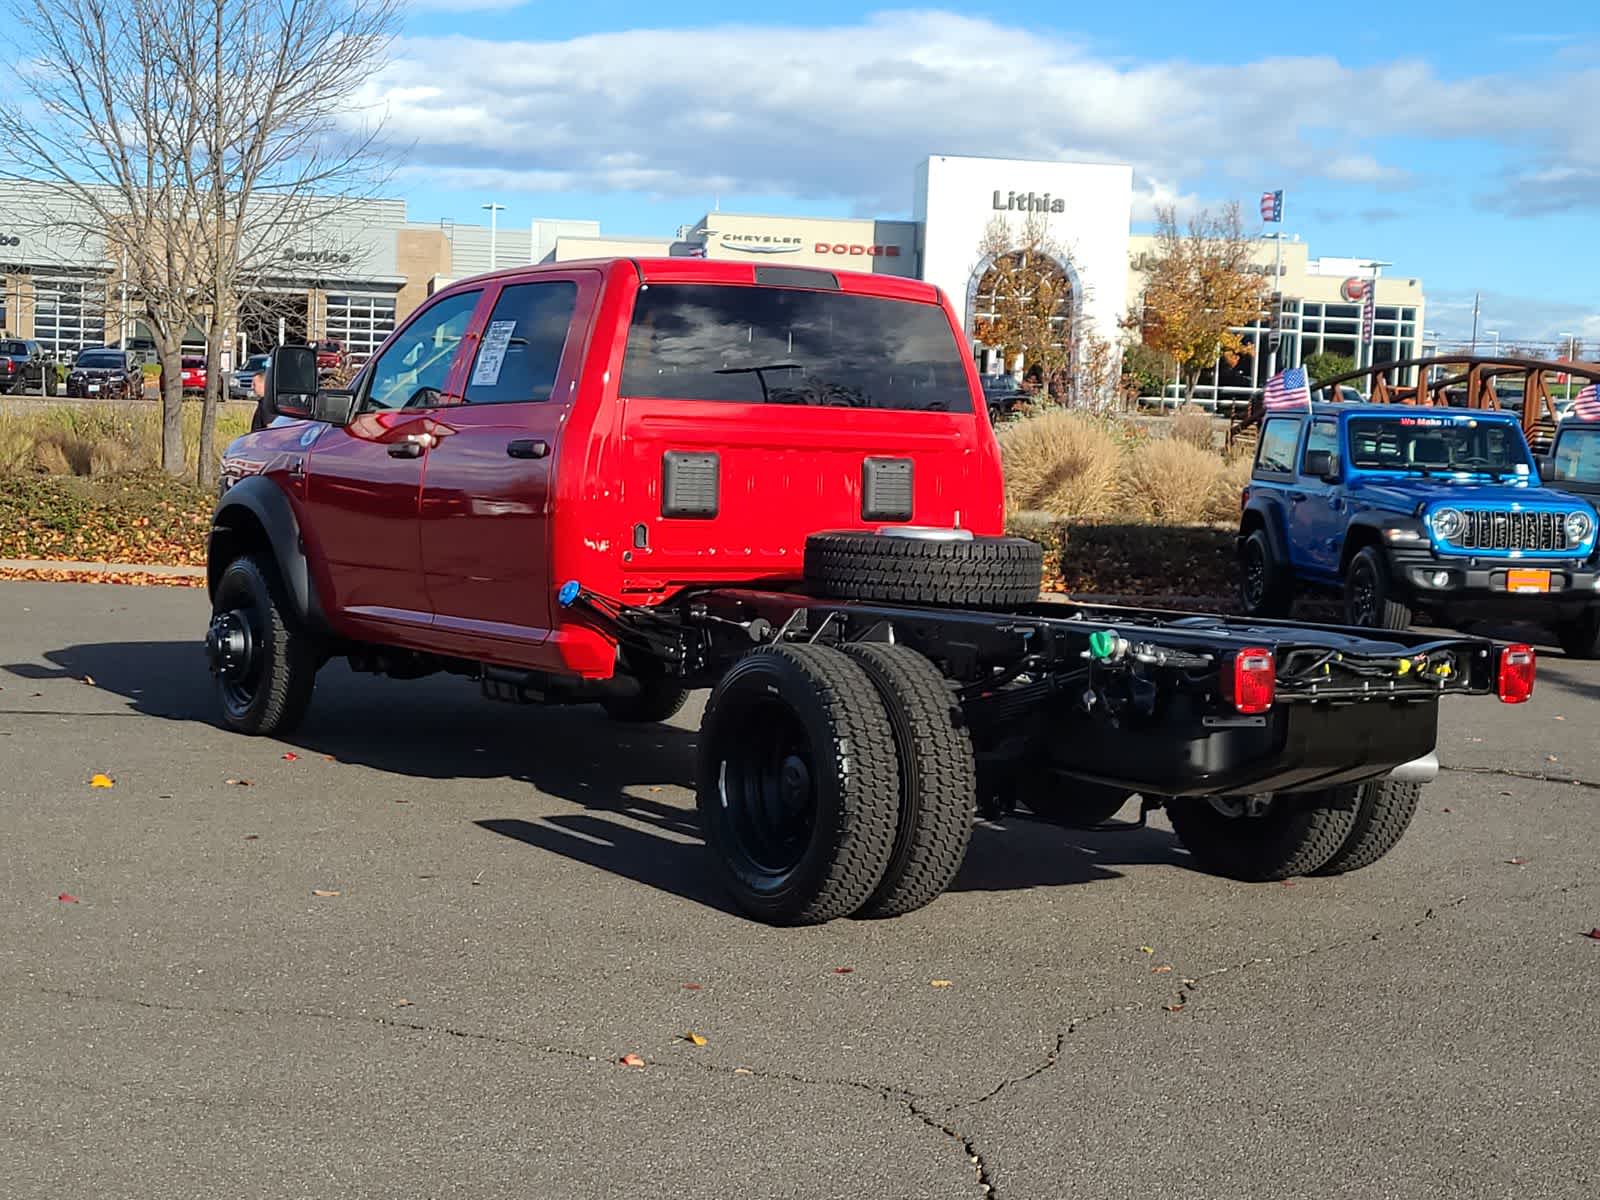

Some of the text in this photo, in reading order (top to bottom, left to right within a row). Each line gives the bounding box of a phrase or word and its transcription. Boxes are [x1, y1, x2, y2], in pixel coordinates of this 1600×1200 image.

[992, 190, 1066, 213] Lithia
[722, 233, 802, 244] CHRYSLER
[283, 247, 350, 264] Service
[815, 242, 901, 257] DODGE
